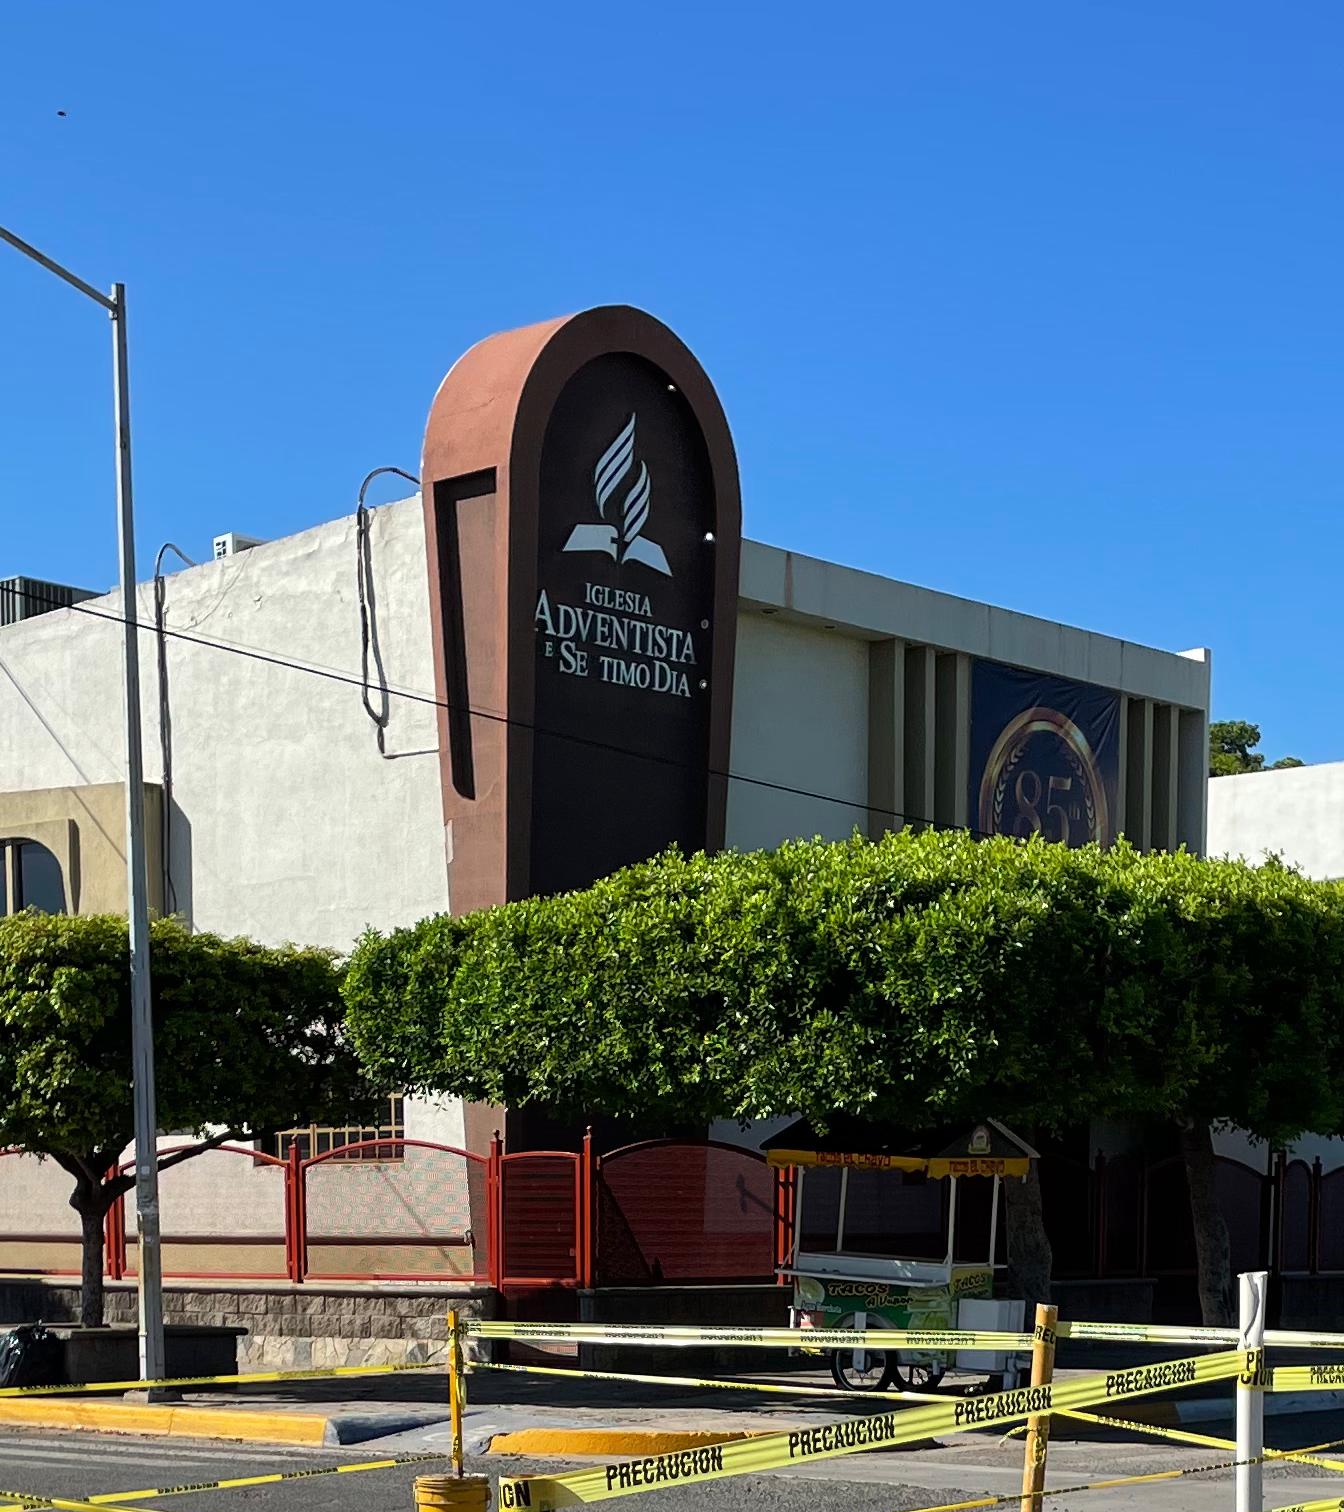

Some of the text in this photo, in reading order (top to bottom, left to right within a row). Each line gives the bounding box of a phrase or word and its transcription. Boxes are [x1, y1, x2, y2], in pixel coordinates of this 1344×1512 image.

[534, 588, 698, 665] ADVENTISTA
[585, 582, 653, 617] IGLESIA
[828, 1283, 890, 1296] TACOS
[605, 1446, 724, 1491] PRECAUCION
[788, 1415, 896, 1458] PRECAUCION
[954, 1385, 1053, 1426] PRECAUCION
[1105, 1360, 1196, 1397] PRECAUCION
